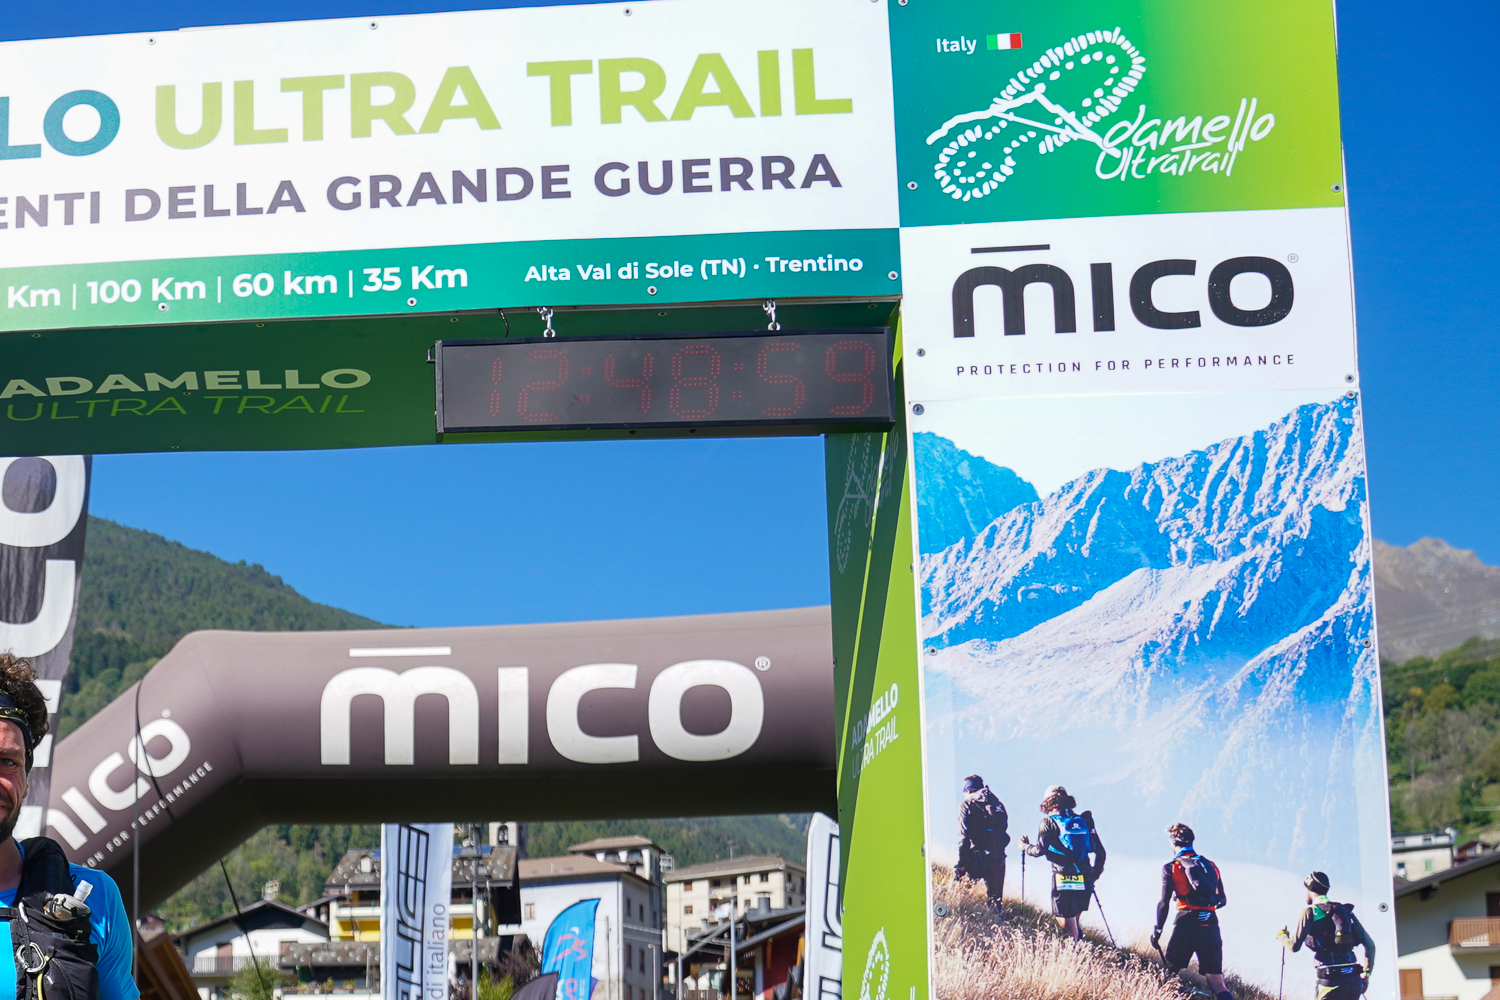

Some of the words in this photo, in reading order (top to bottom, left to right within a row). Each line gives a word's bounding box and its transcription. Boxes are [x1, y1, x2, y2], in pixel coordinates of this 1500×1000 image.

[935, 35, 977, 56] Italy
[154, 65, 502, 150] ULTRA
[527, 47, 853, 128] TRAIL
[124, 180, 306, 222] DELLA
[327, 164, 572, 212] GRANDE
[594, 153, 842, 197] GUERRA
[7, 284, 61, 310] Km
[86, 278, 143, 304] 100
[150, 274, 205, 301] Km
[232, 272, 274, 298] 60
[283, 268, 337, 296] km
[363, 267, 403, 294] 35
[413, 264, 468, 291] Km
[524, 263, 572, 284] Alta
[575, 261, 612, 282] Val
[617, 260, 639, 281] di
[644, 258, 695, 280] Sole
[700, 256, 747, 281] (TN)
[765, 252, 864, 275] Trentino
[488, 339, 876, 422] 12:48:59
[956, 360, 1082, 376] PROTECTION
[1095, 358, 1132, 371] FOR
[1143, 354, 1296, 370] PERFORMANCE
[6, 397, 188, 421] ULTRA
[203, 395, 365, 415] TRAIL
[851, 682, 899, 751] ADAMELLO
[875, 715, 899, 756] TRAIL
[105, 829, 131, 853] FOR
[427, 902, 446, 976] italiano
